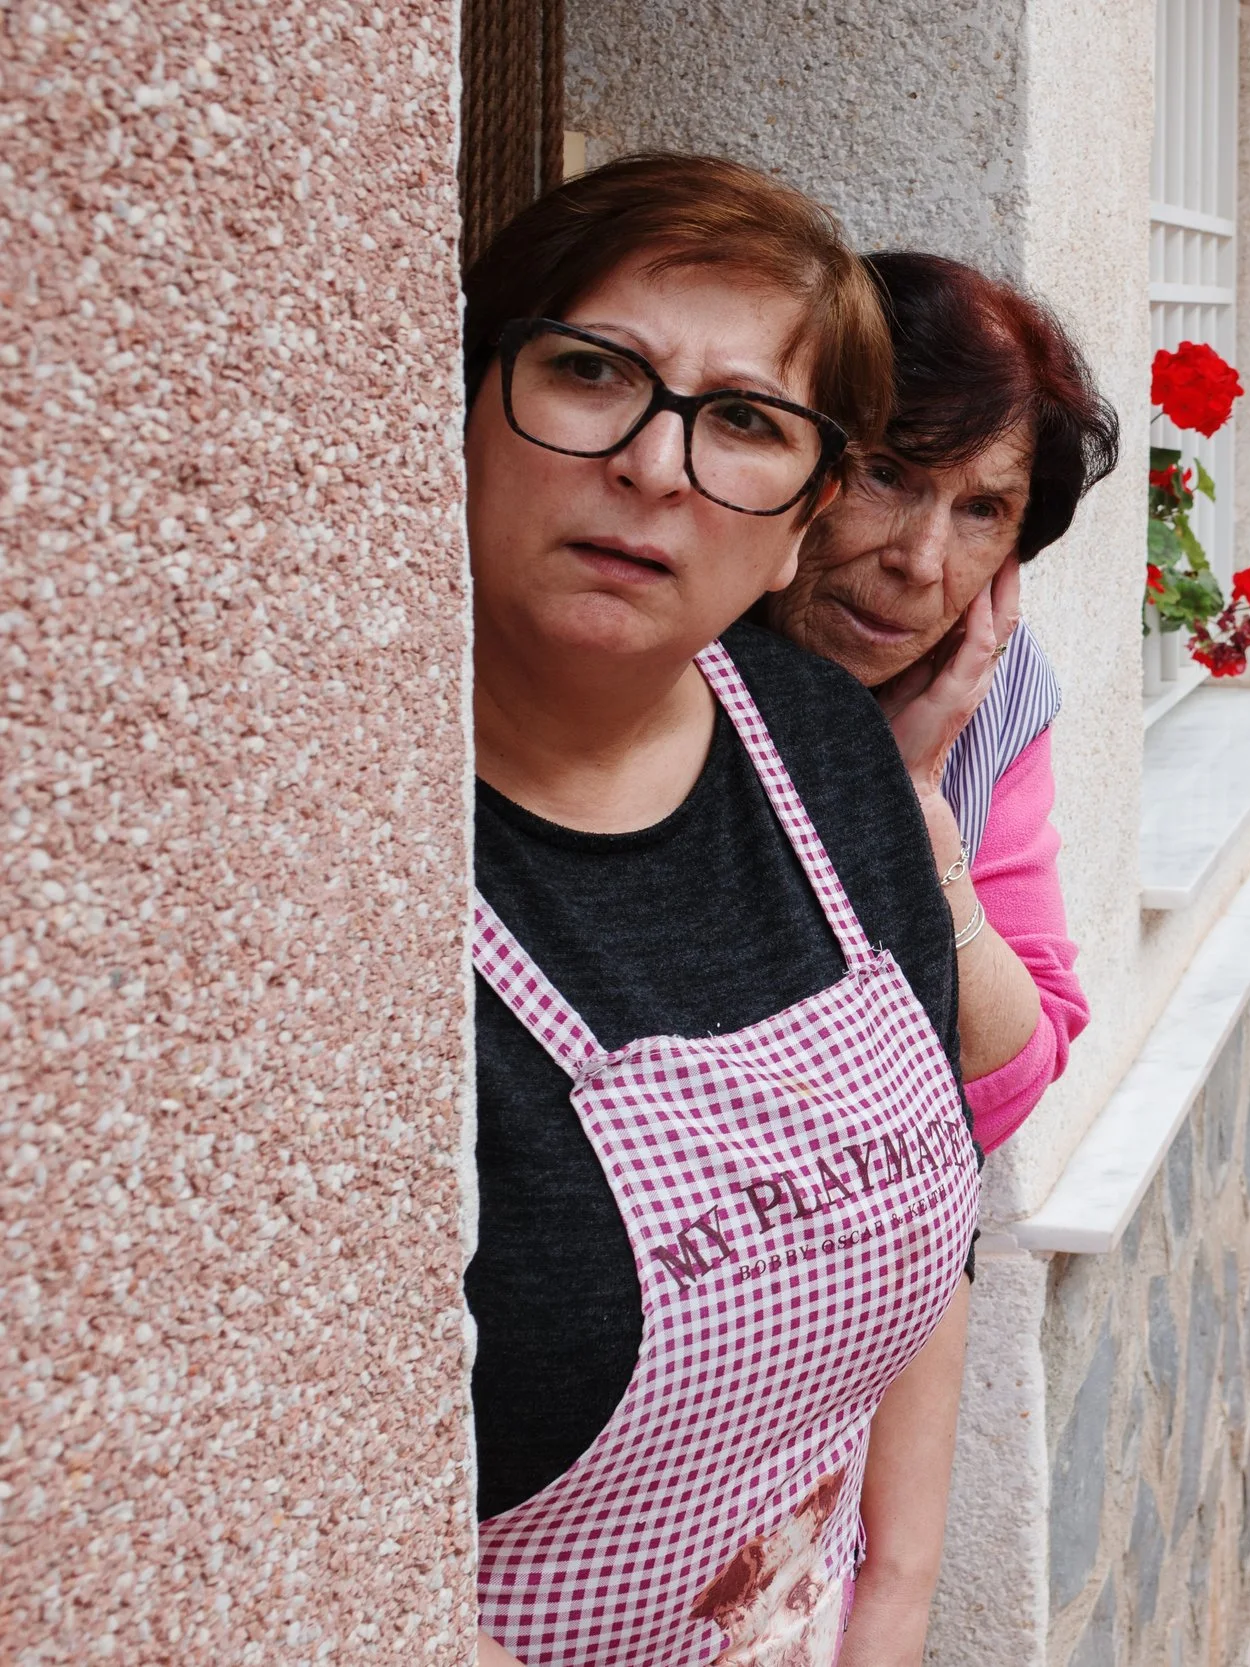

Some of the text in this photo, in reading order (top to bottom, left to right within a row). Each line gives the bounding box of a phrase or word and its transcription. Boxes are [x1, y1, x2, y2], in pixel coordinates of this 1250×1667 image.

[650, 1120, 965, 1294] MY PLAYMATE
[821, 1220, 885, 1252] OSCAR
[890, 1213, 904, 1225] &
[908, 1184, 948, 1220] KEITH
